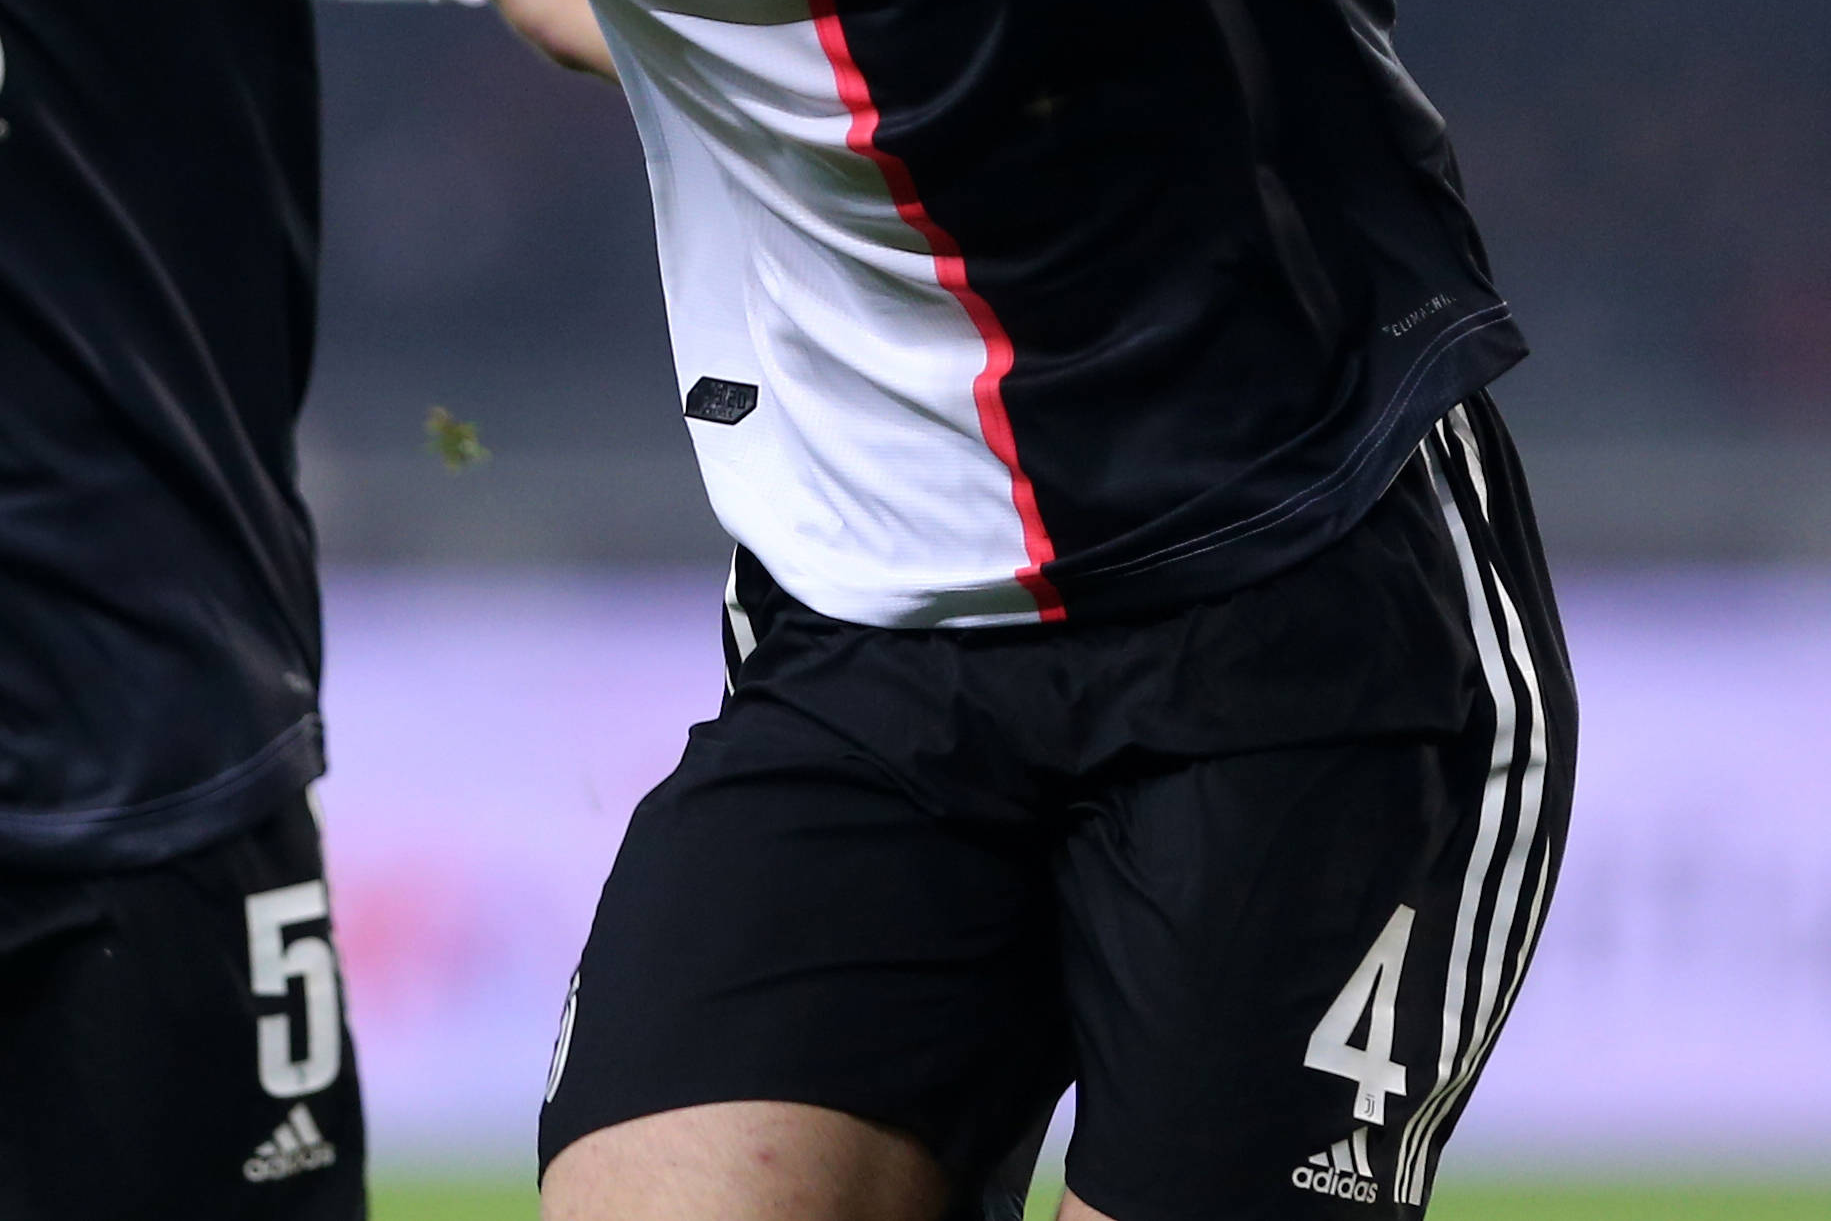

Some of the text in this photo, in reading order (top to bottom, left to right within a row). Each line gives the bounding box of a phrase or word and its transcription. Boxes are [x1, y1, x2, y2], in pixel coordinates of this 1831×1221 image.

[245, 878, 342, 1099] 5
[1303, 903, 1416, 1126] 4
[1291, 1166, 1378, 1203] adidas
